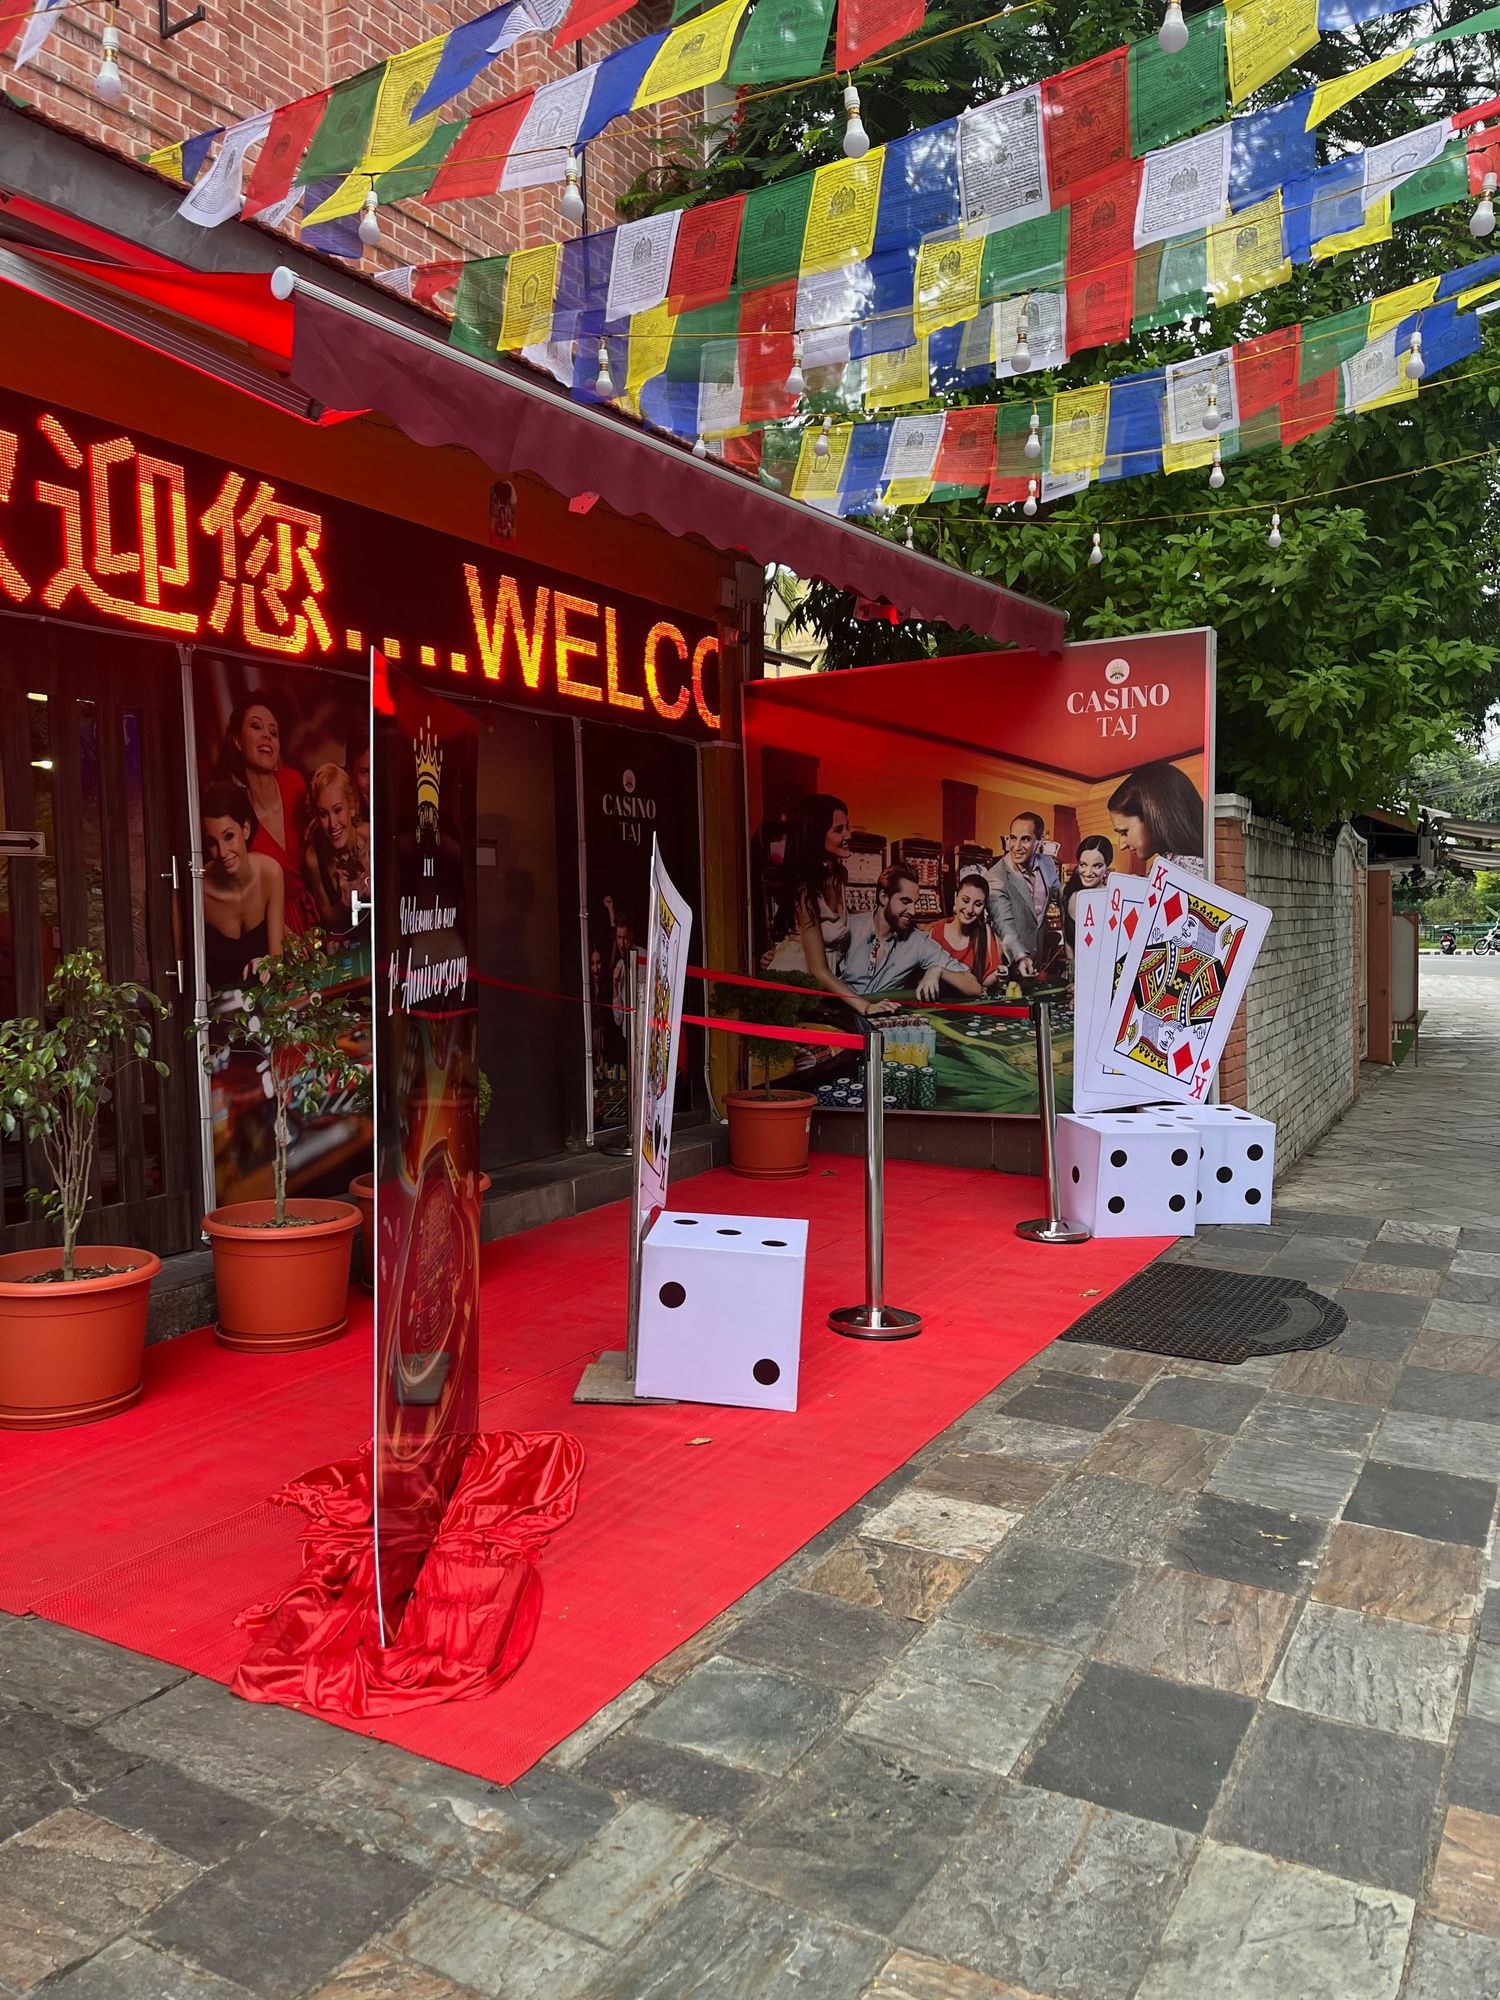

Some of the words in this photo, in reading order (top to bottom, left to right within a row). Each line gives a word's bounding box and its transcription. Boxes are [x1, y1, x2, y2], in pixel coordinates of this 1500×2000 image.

[1066, 683, 1170, 714] CASINO
[1096, 714, 1138, 740] TAJ
[602, 794, 656, 819] CASINO
[619, 821, 641, 846] TAJ
[1152, 865, 1168, 891] K
[1111, 888, 1120, 912] Q
[400, 896, 433, 935] Welcome
[435, 895, 442, 929] to
[443, 907, 457, 928] our
[1083, 903, 1095, 927] A
[388, 949, 399, 1017] 1st
[401, 947, 468, 1014] Anniversary
[1188, 1074, 1207, 1100] K
